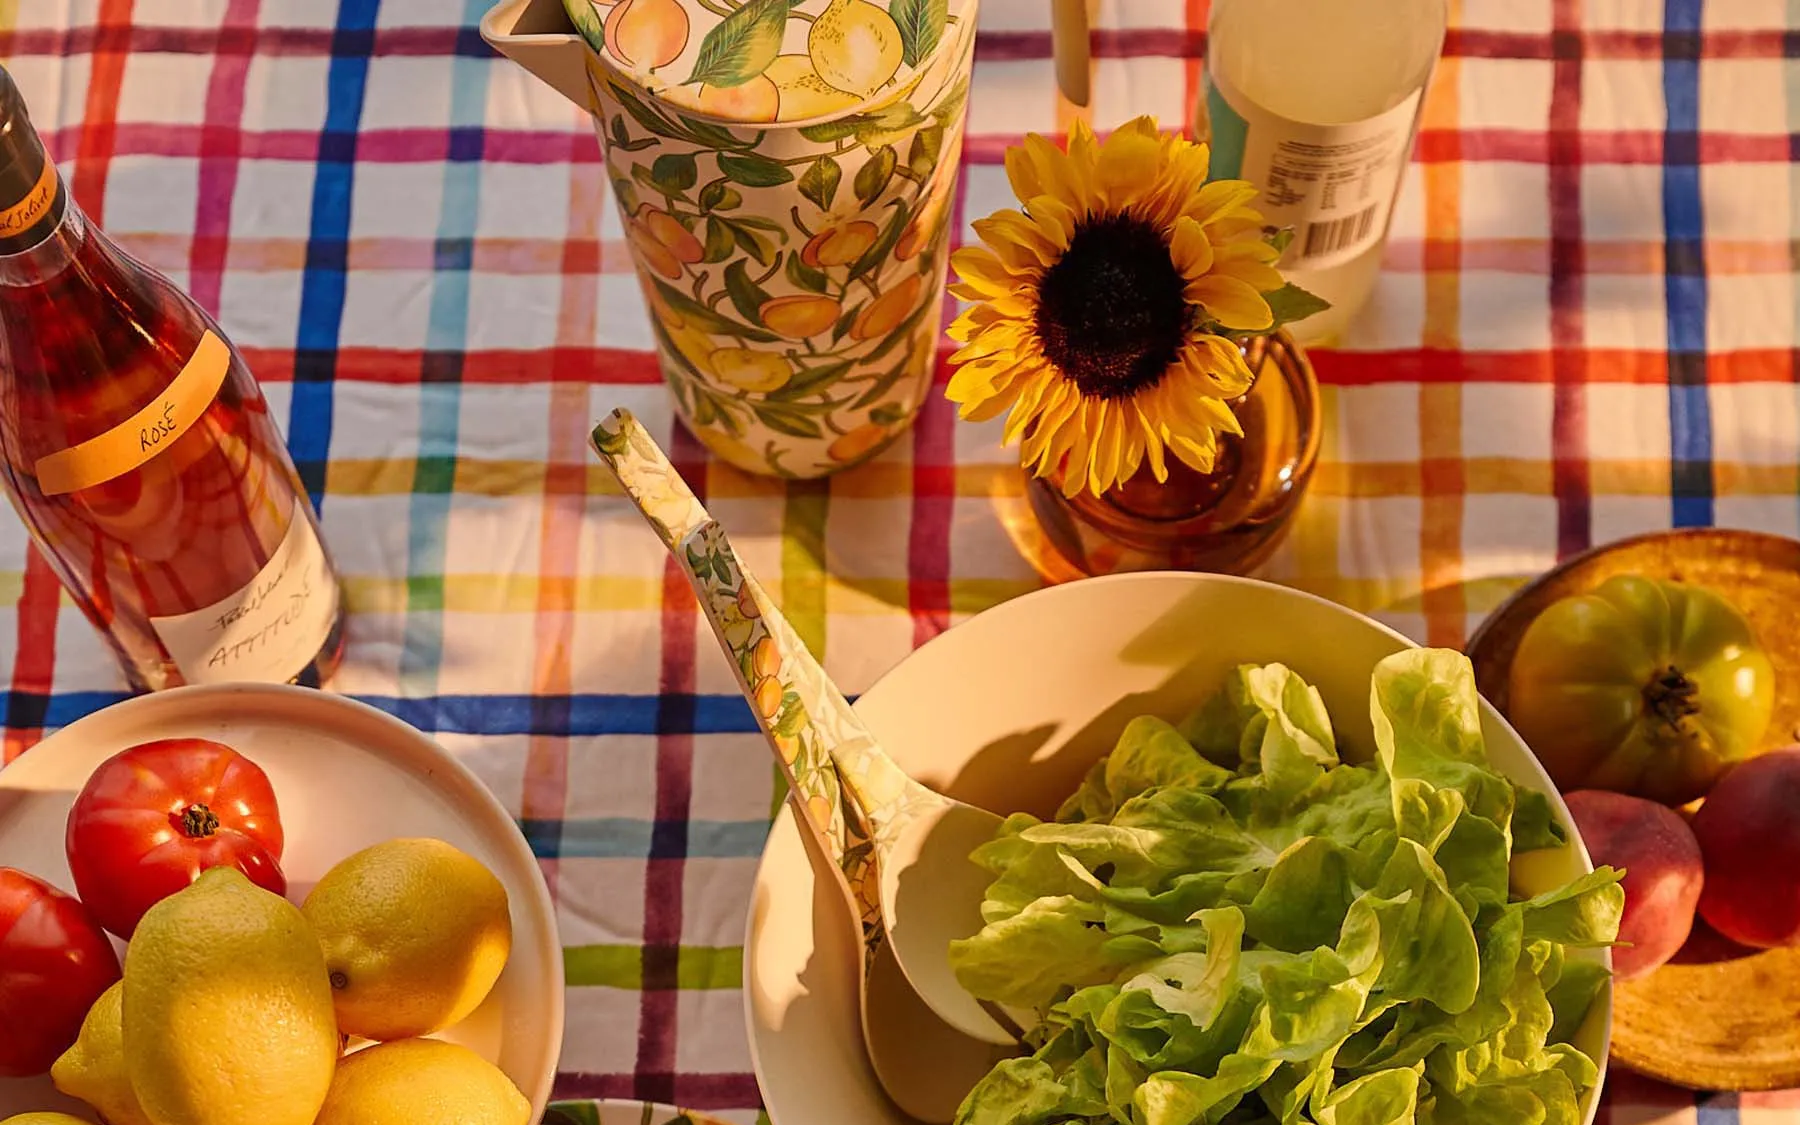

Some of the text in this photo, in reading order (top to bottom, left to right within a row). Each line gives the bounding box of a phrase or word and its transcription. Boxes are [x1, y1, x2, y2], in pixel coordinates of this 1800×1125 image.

[16, 187, 48, 228] Jolivet
[141, 401, 177, 452] ROSÉ
[209, 564, 312, 668] ATTITUDE
